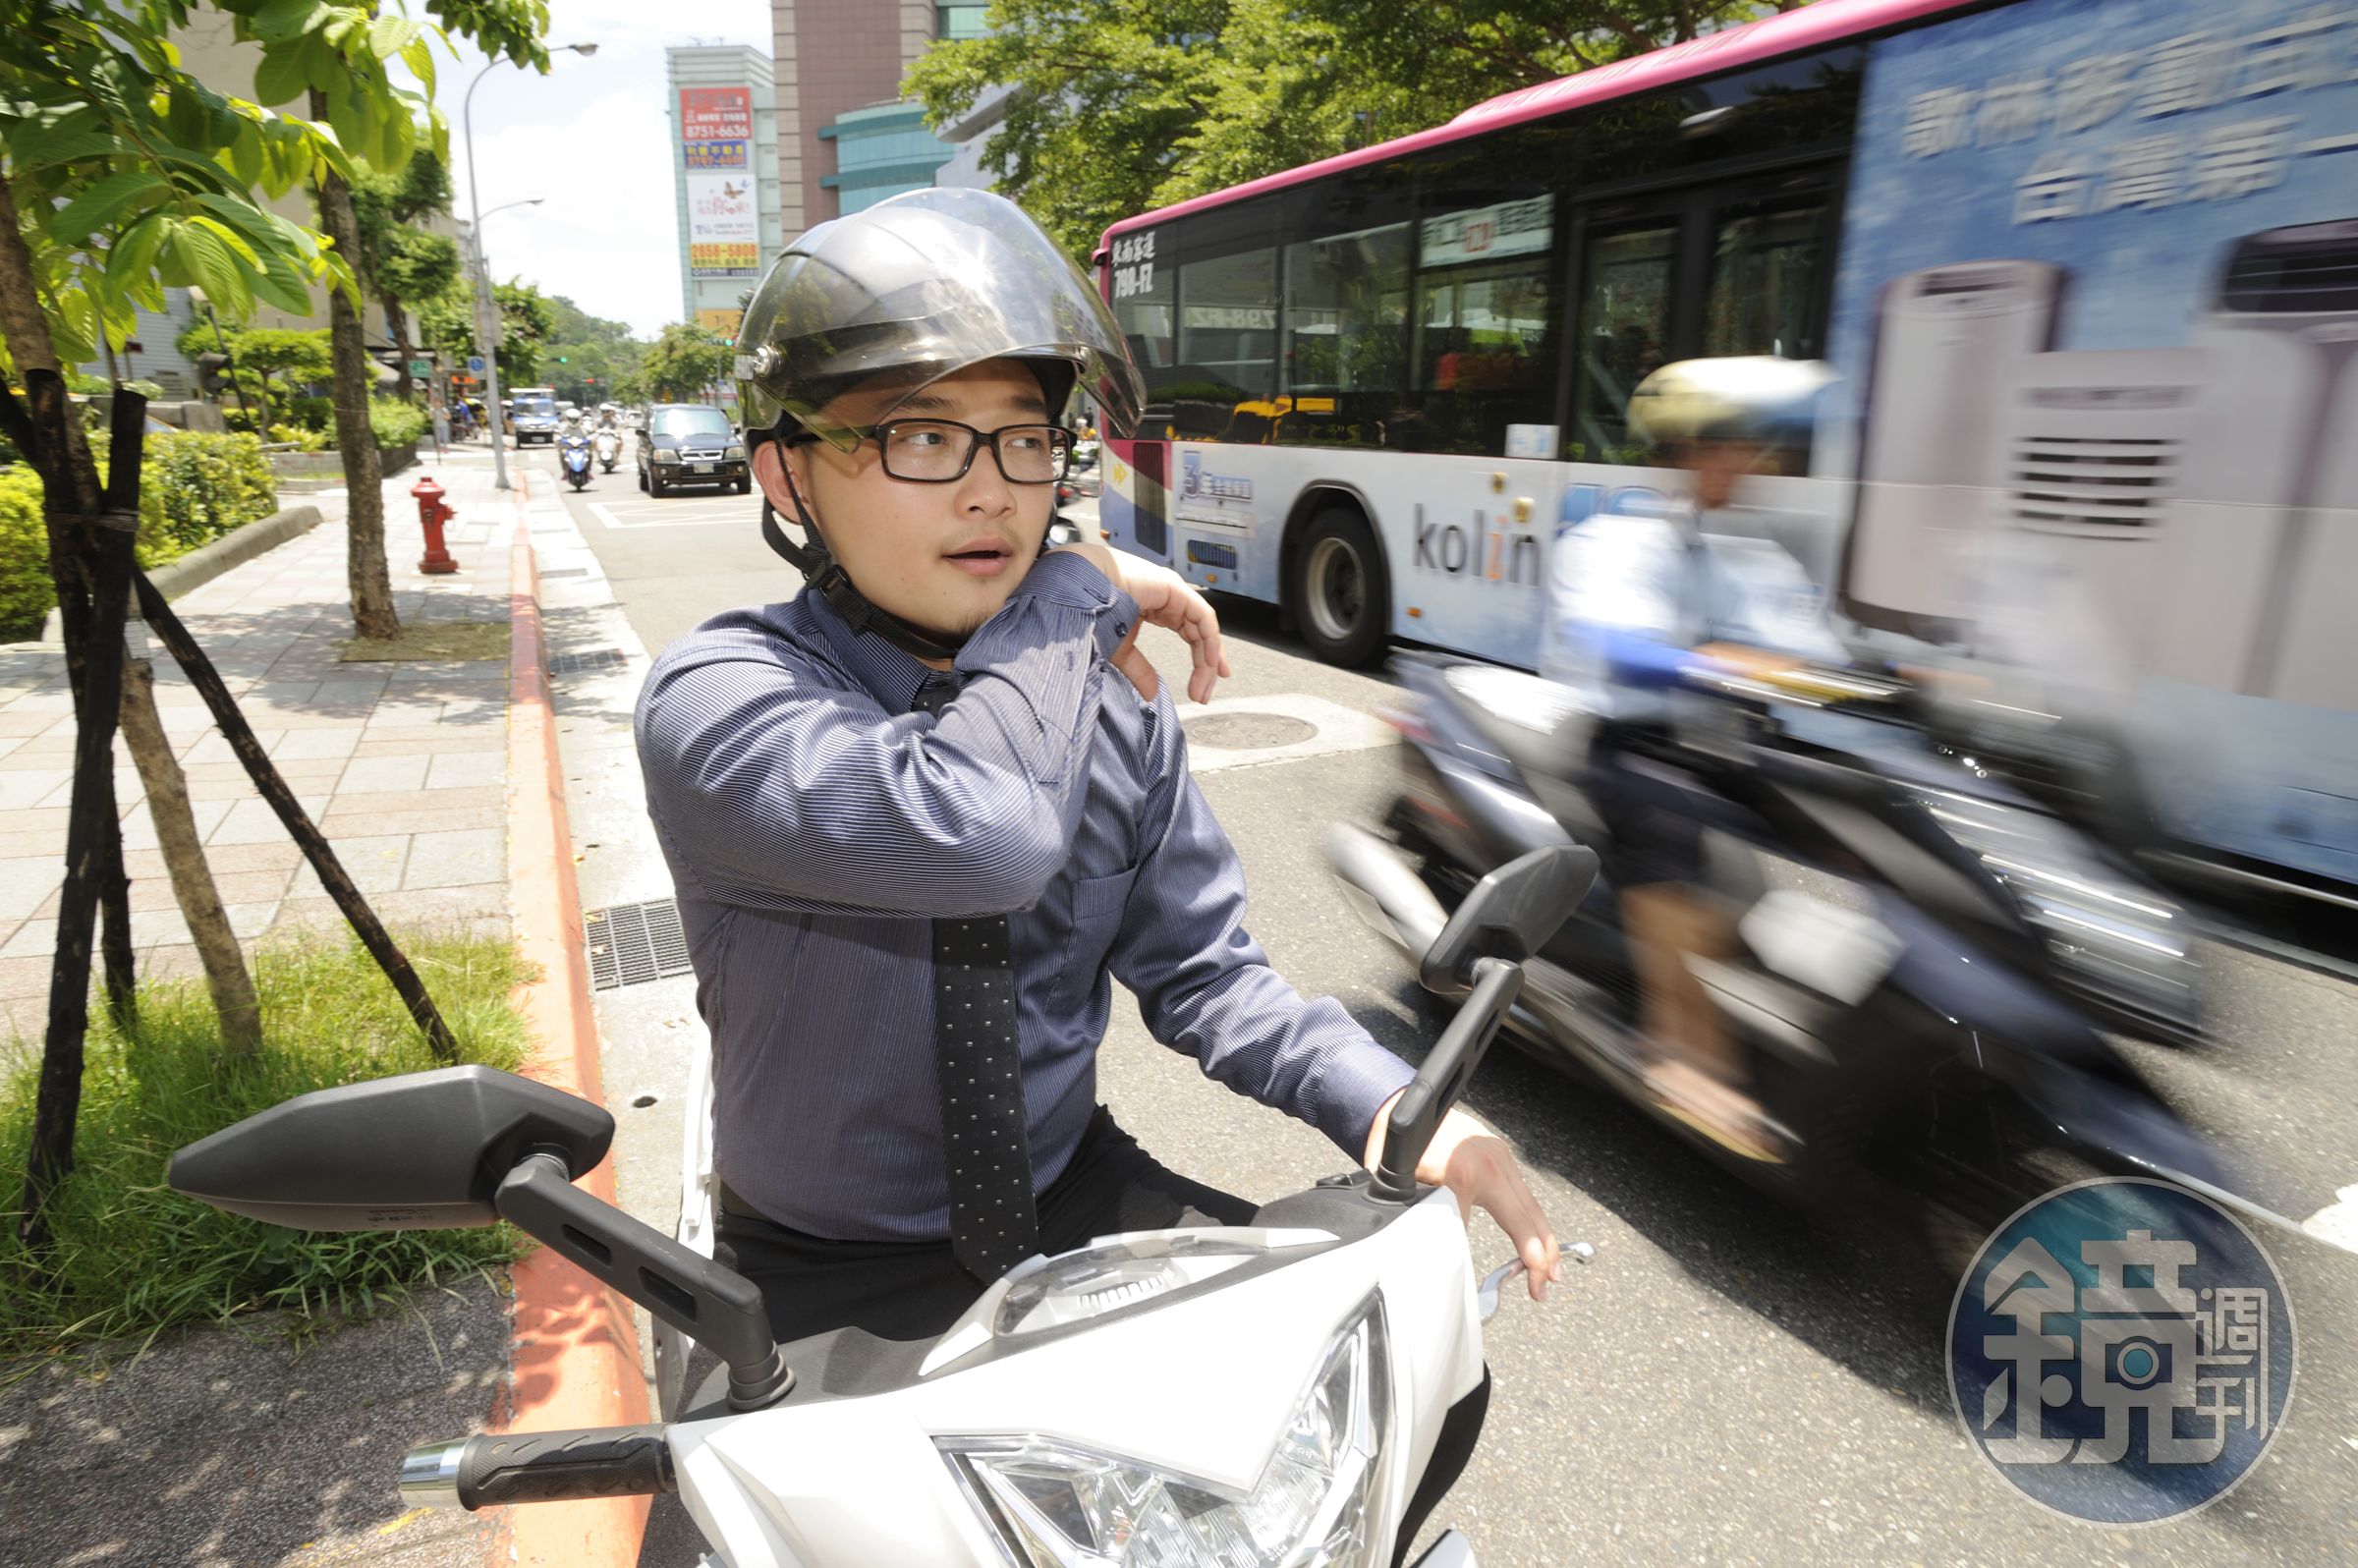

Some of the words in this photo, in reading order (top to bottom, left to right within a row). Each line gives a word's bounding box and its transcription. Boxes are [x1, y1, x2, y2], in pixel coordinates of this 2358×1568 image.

[1111, 231, 1155, 267] 東南客運
[1114, 262, 1153, 299] 798-FZ
[1413, 503, 1542, 588] kolin
